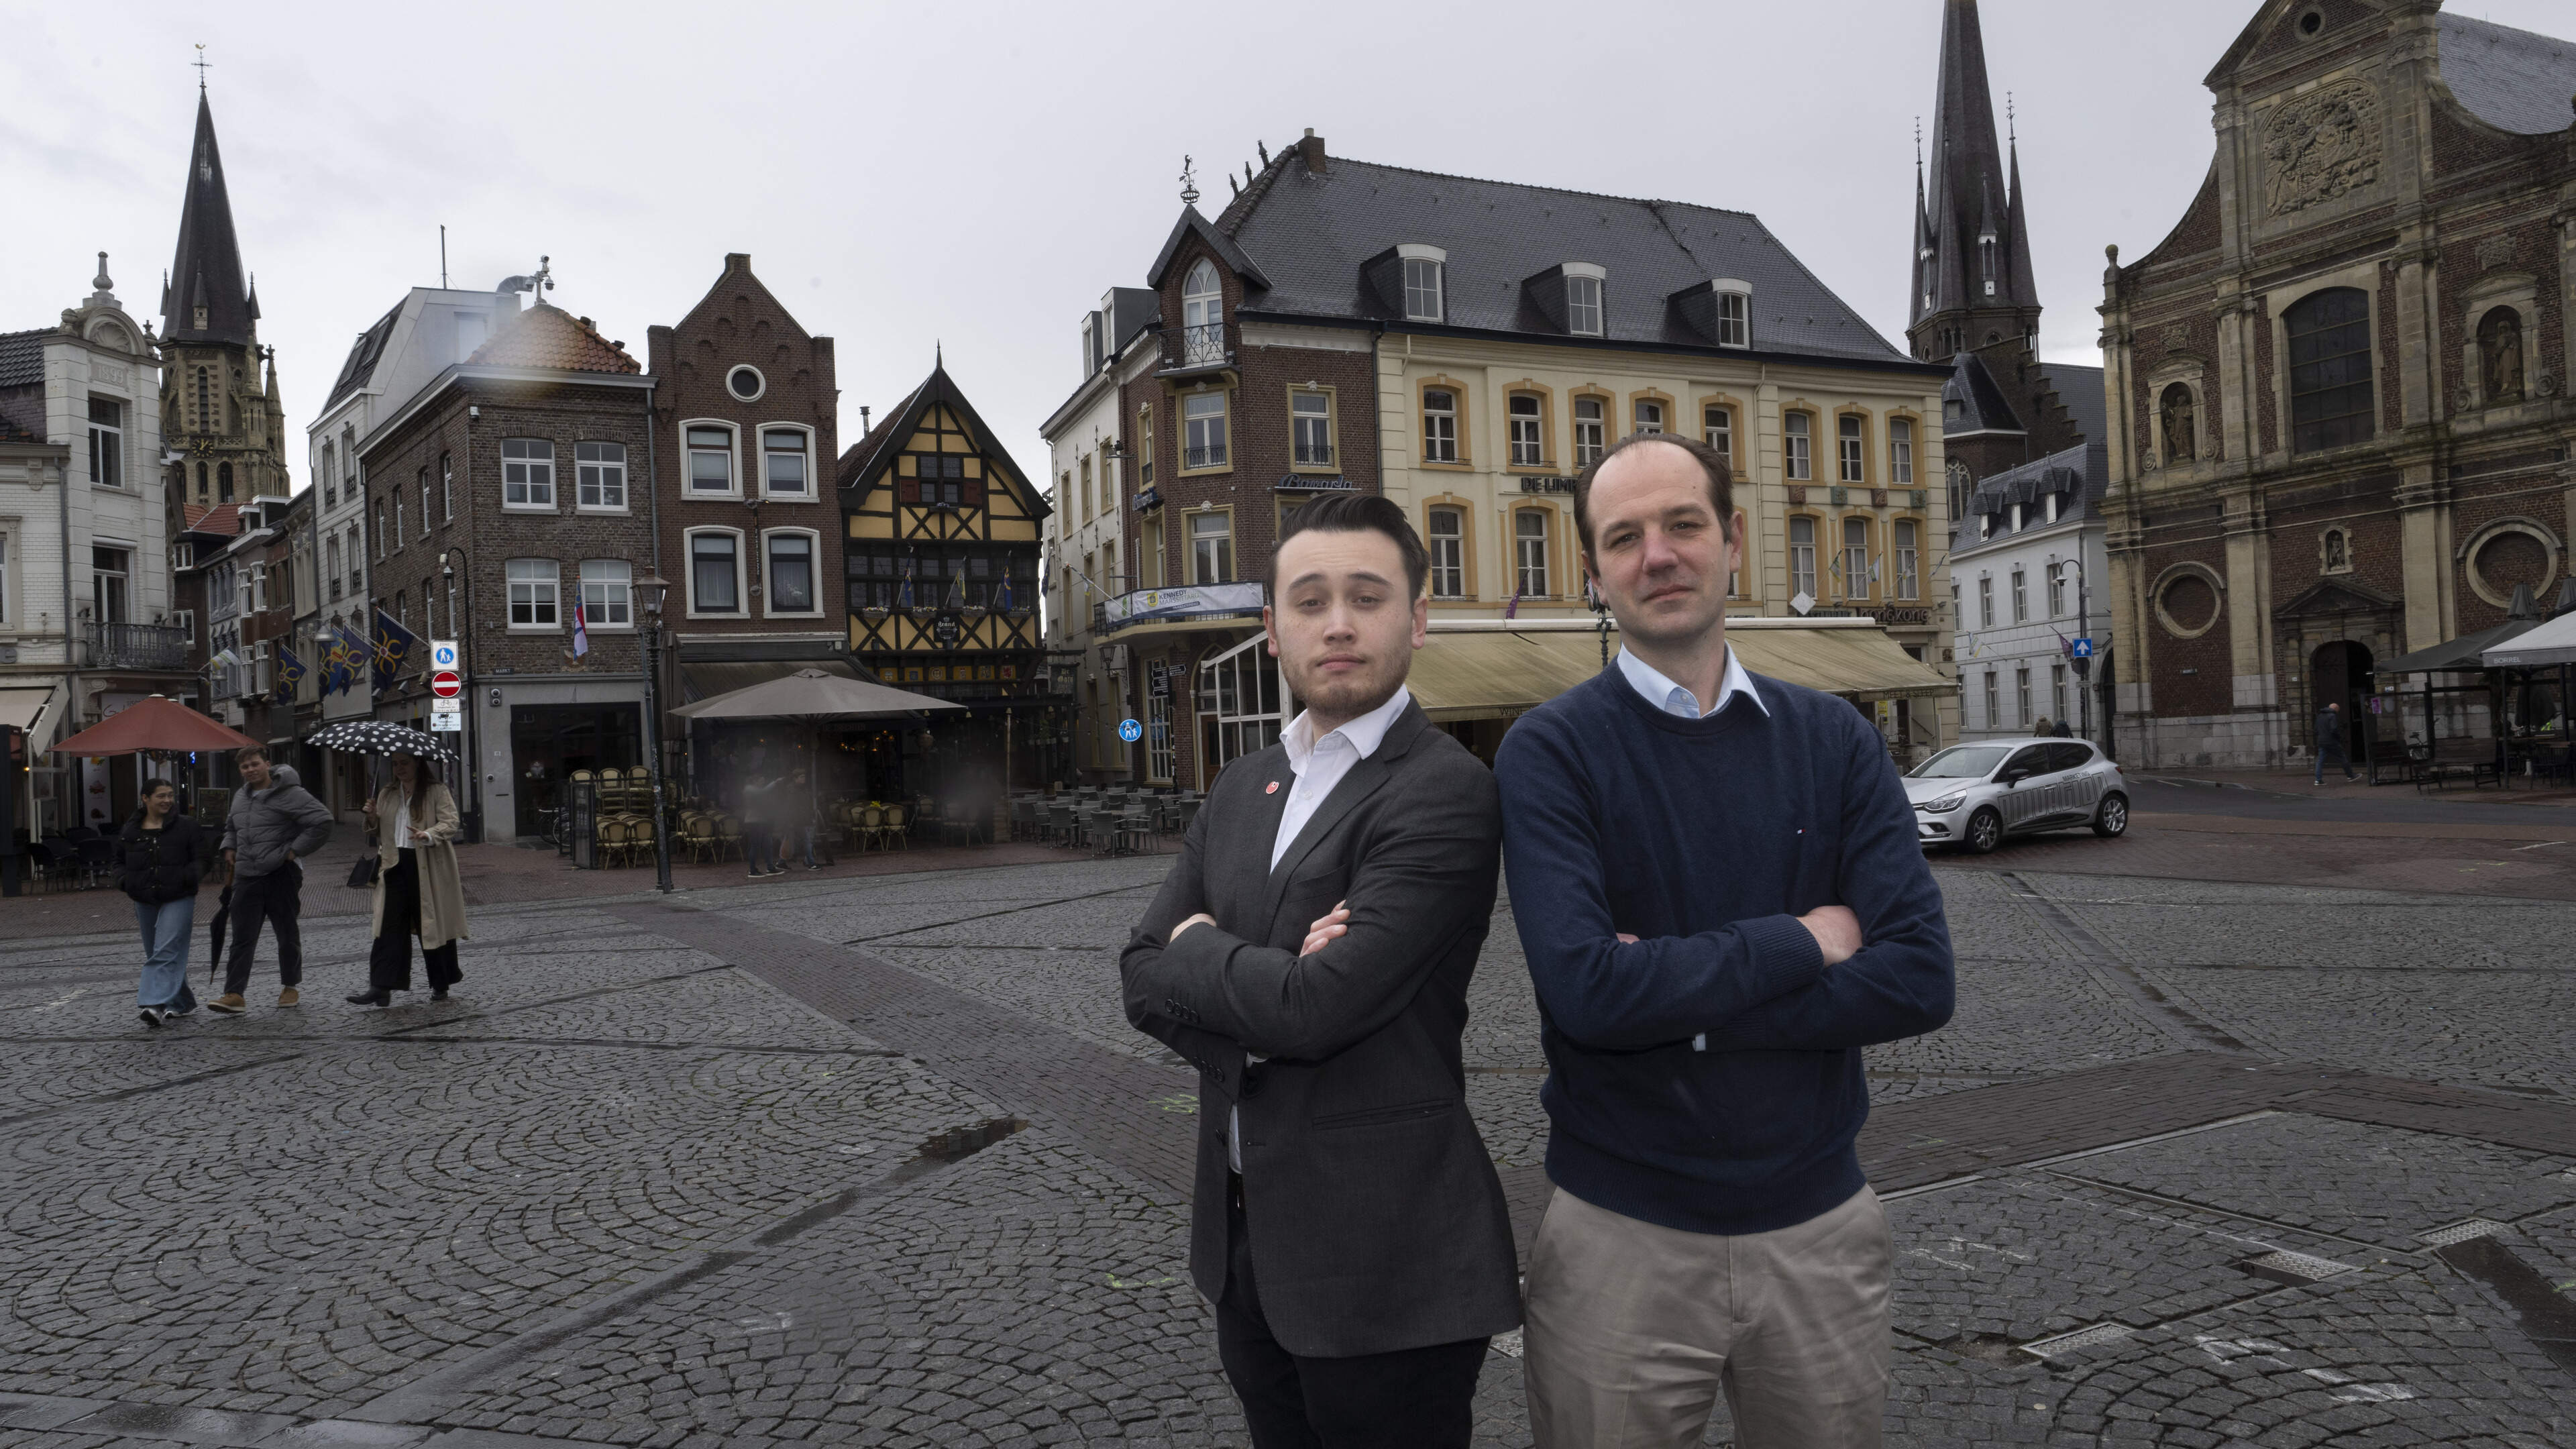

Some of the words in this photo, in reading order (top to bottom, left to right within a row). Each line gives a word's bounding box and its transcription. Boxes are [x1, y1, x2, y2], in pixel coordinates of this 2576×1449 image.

[1279, 474, 1352, 488] Bavaria
[1521, 477, 1542, 490] DE
[1159, 590, 1187, 599] KENNEDY
[2493, 656, 2522, 664] BORREL
[2062, 771, 2090, 781] MARKETING
